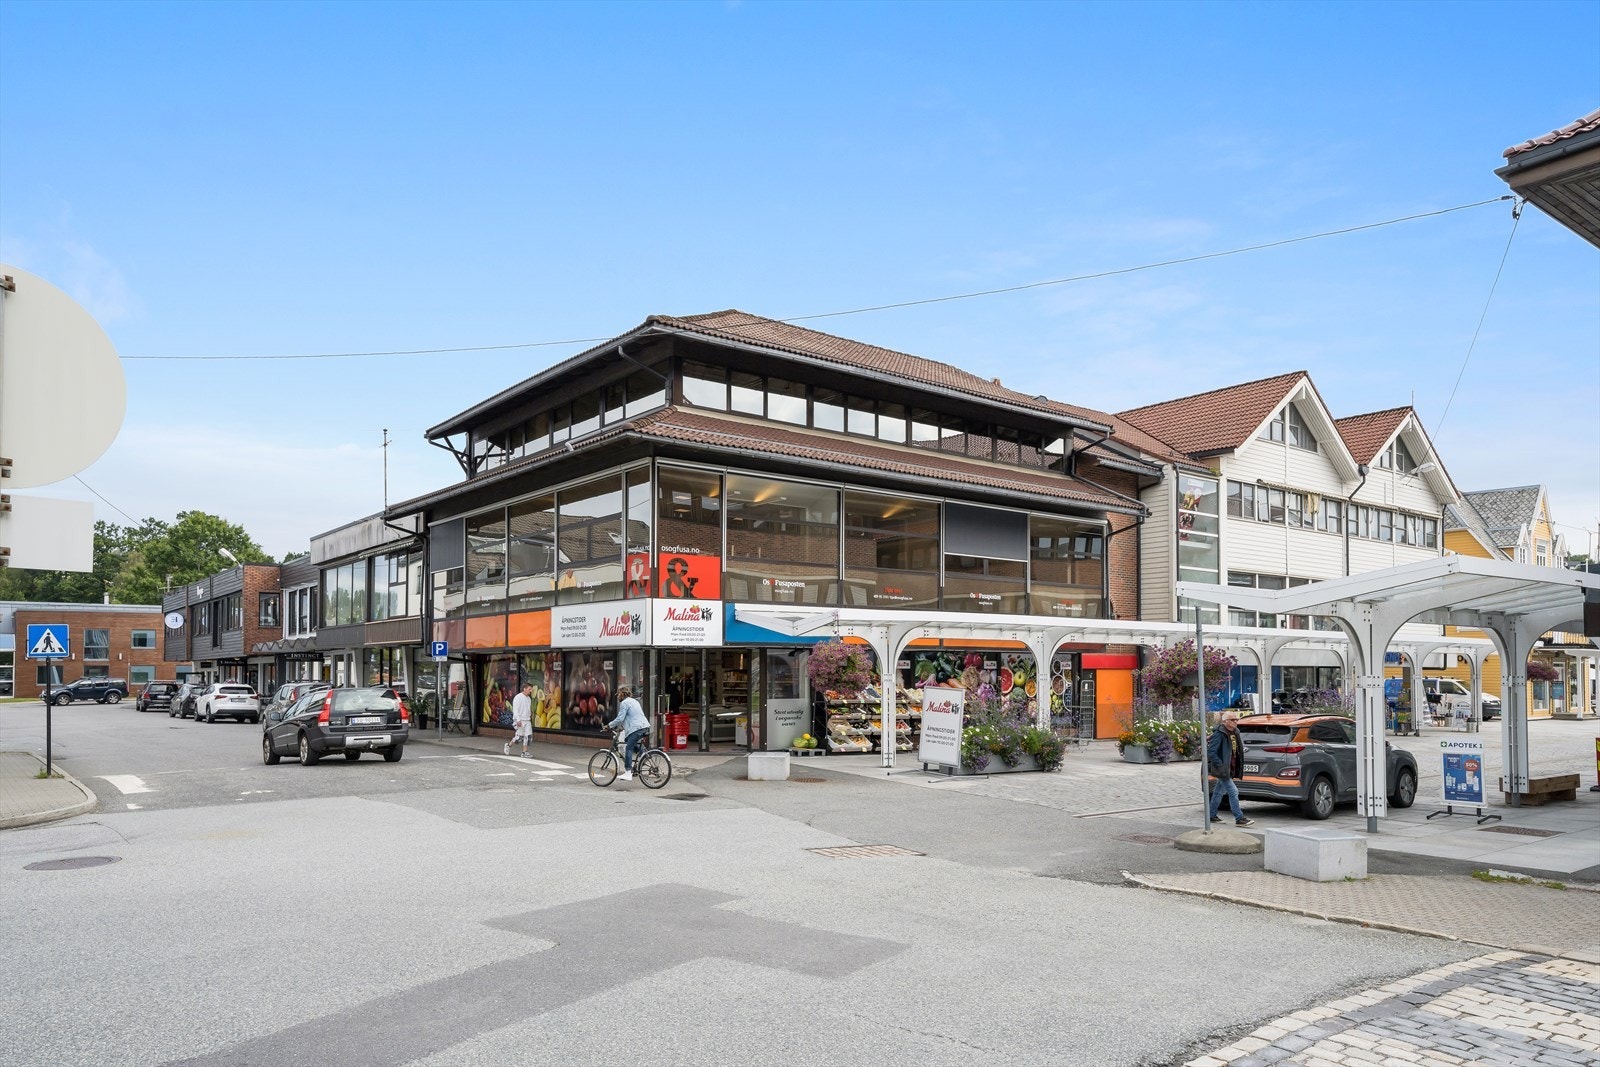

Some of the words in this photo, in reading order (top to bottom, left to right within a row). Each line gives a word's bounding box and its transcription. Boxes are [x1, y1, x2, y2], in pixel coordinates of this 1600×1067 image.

[661, 545, 700, 554] osogfusa.no
[561, 616, 587, 624] ÅPNINGSTIDER
[663, 607, 702, 621] Malina
[599, 616, 632, 638] Malina
[436, 643, 444, 655] P
[926, 701, 951, 714] Malina
[926, 725, 956, 734] ÅPNINGSTIDER
